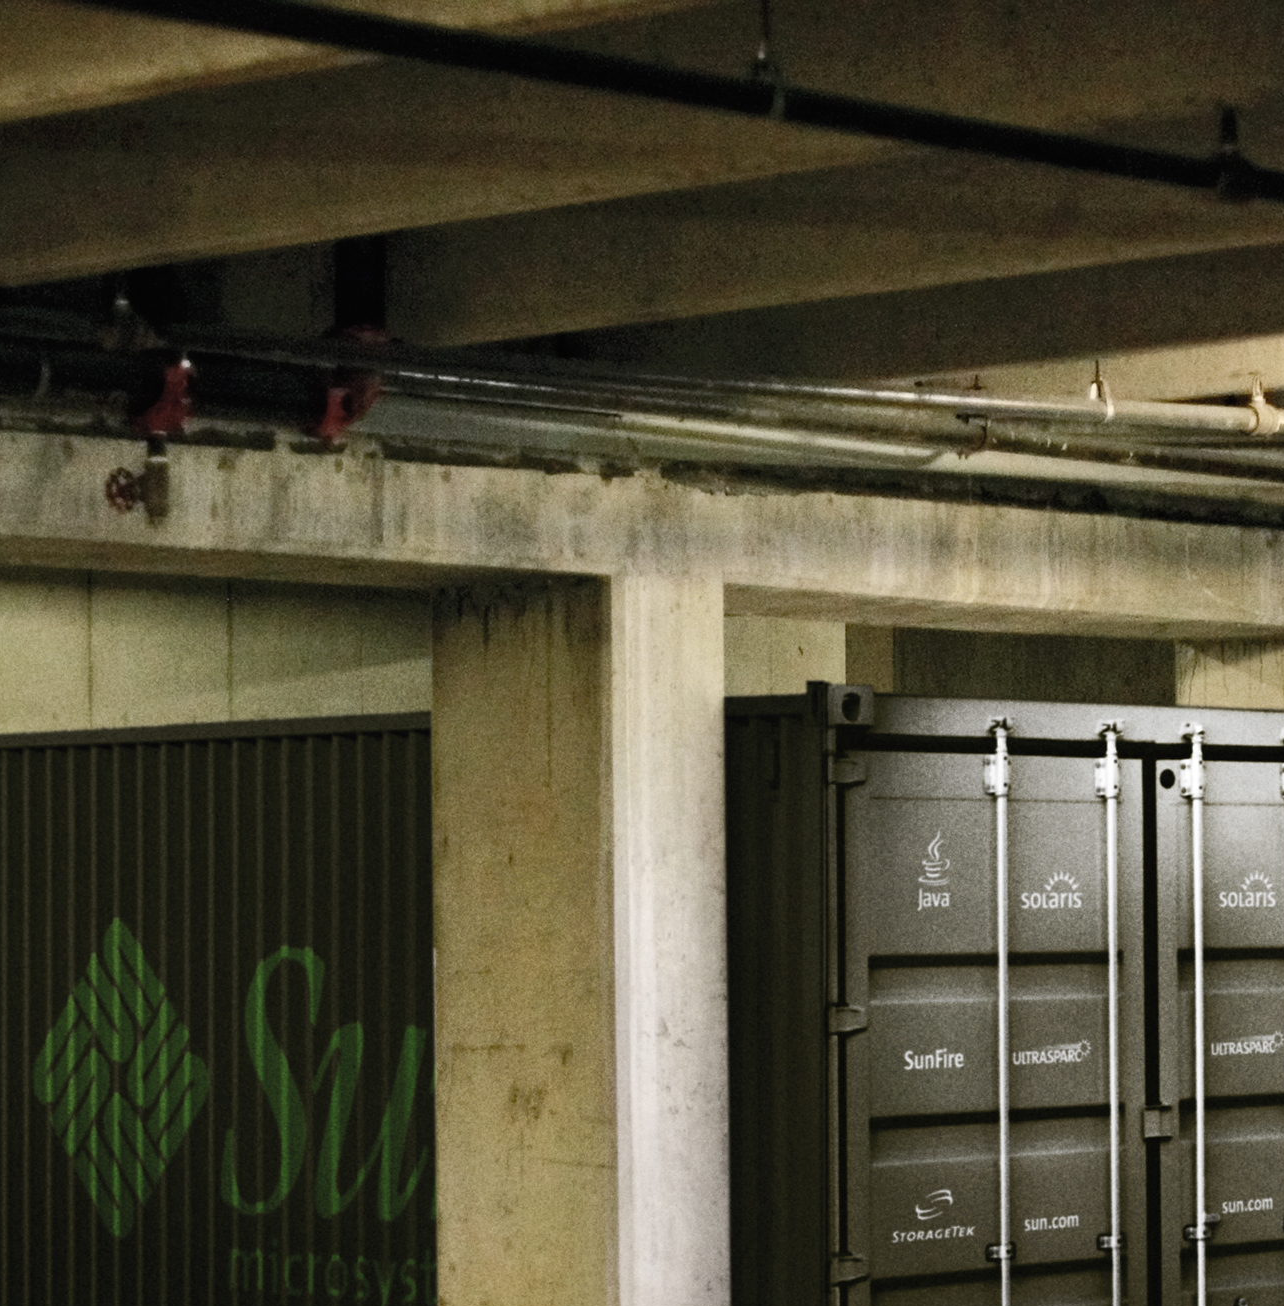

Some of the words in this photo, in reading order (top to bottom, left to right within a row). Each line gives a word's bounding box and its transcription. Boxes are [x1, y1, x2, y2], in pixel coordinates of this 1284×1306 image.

[917, 889, 951, 911] Java
[1012, 1048, 1083, 1065] ULTRASPARC
[1210, 1040, 1277, 1056] ULTRASPARC
[904, 1049, 965, 1070] SunFire
[221, 945, 437, 1222] Su
[1222, 1196, 1273, 1213] sun.com
[1024, 1214, 1080, 1232] sun.com
